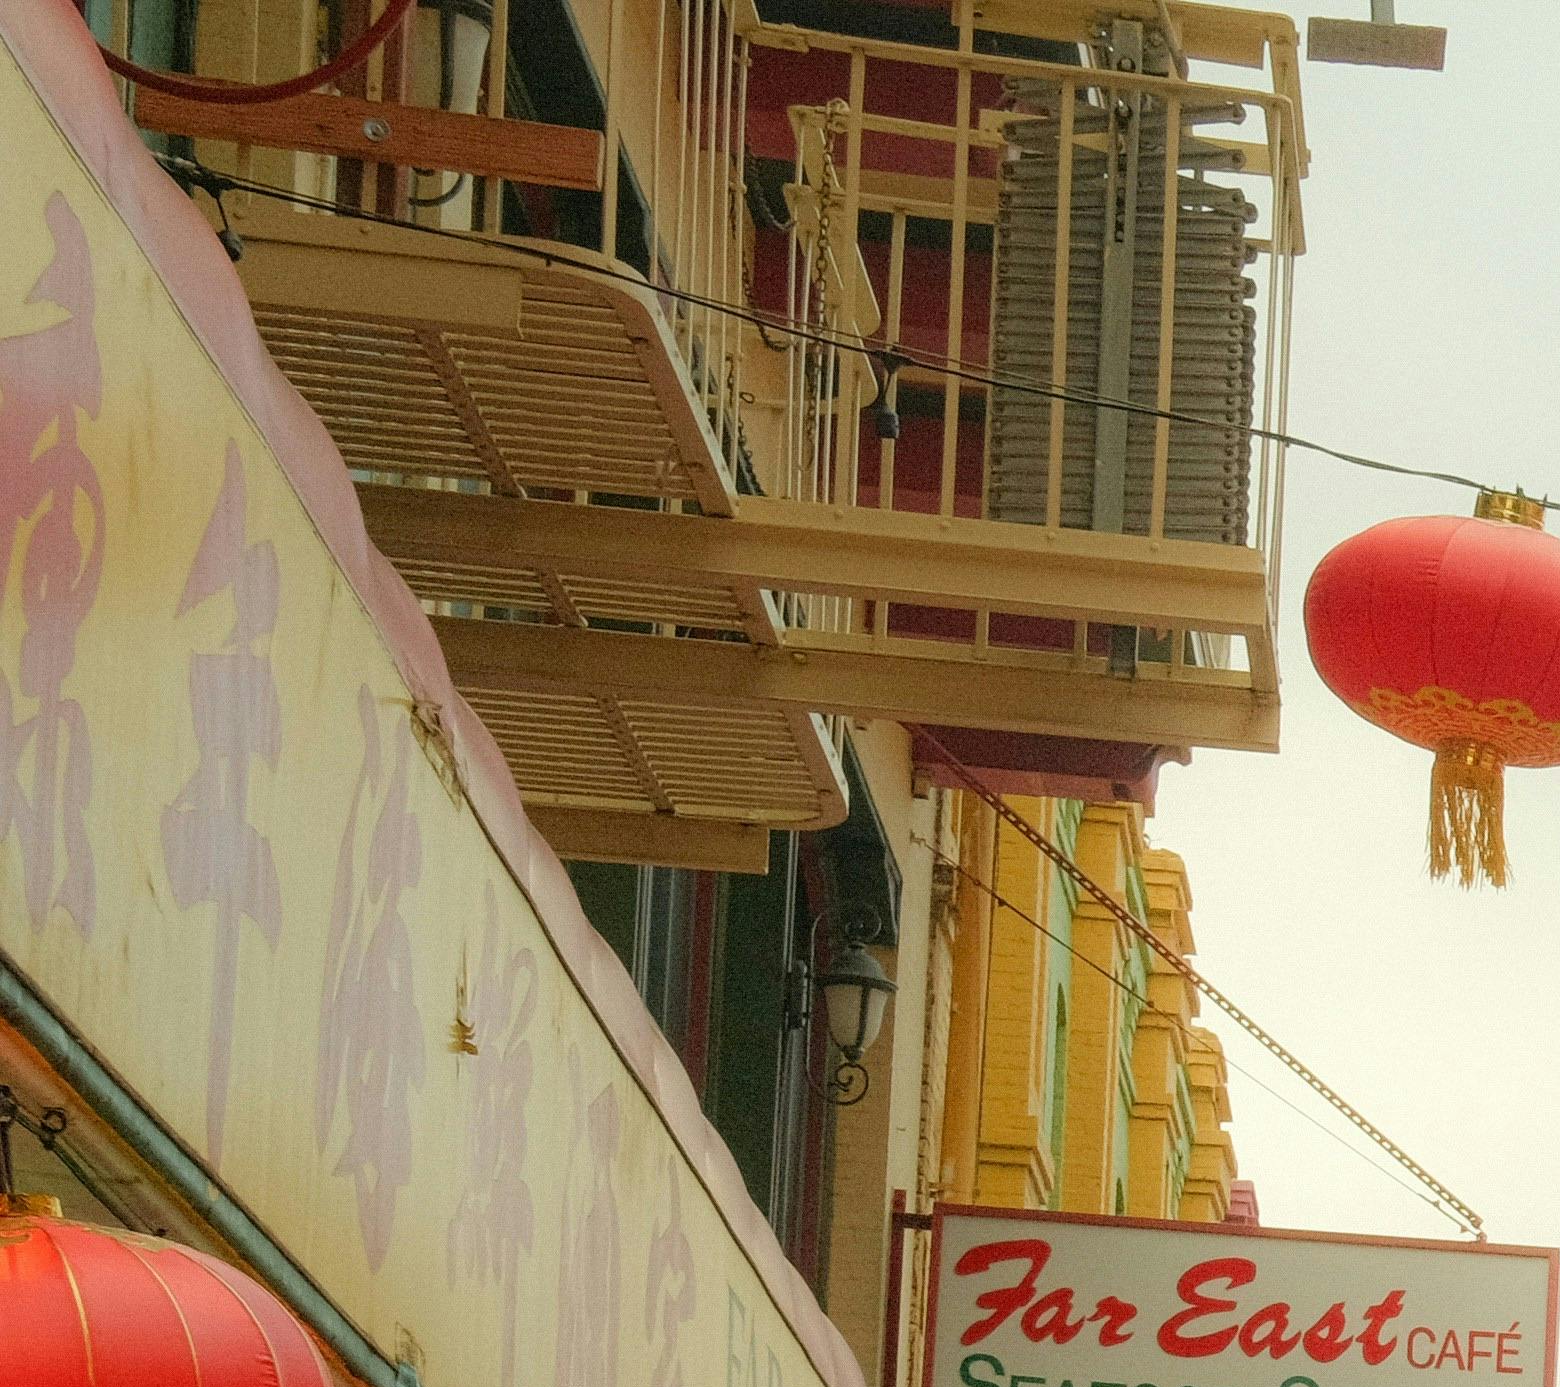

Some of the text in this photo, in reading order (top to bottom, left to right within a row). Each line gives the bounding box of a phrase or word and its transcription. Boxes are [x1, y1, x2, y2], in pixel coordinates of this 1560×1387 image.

[954, 1238, 1523, 1375] Far East CAFÉ
